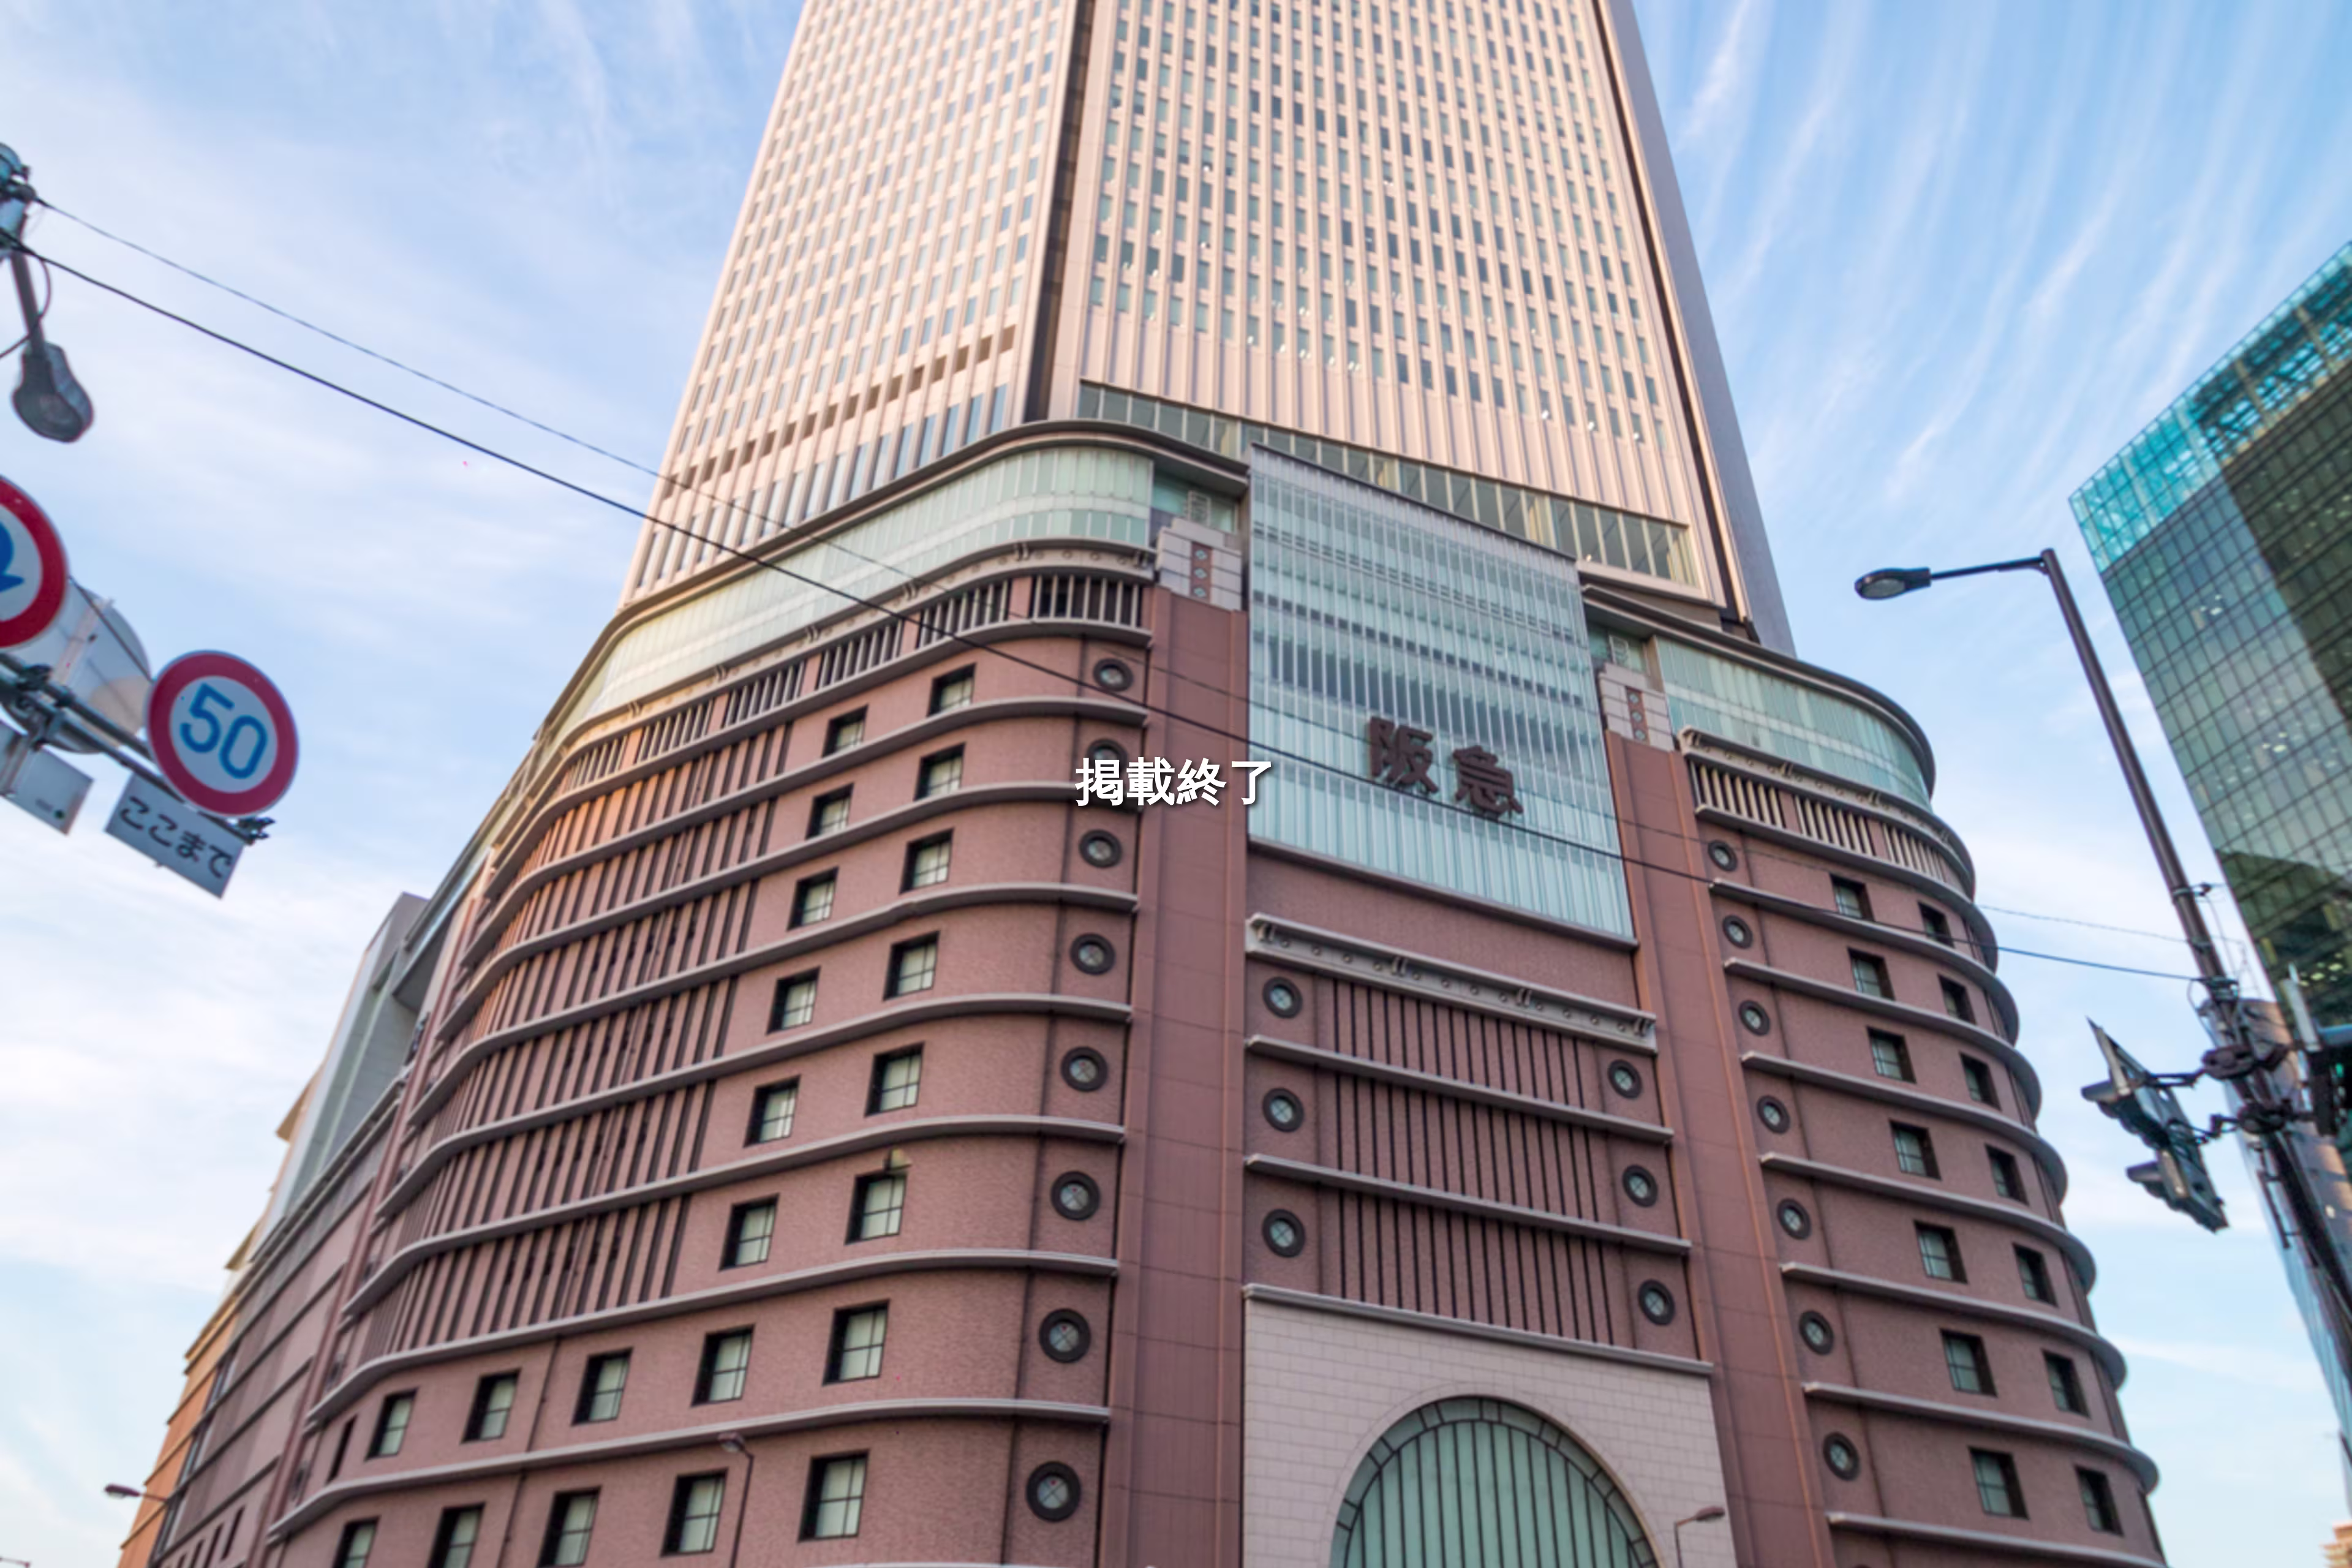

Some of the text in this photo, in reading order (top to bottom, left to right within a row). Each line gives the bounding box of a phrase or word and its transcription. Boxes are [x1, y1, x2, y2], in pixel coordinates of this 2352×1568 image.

[180, 683, 268, 780] 50
[1367, 716, 1523, 816] 阪急
[119, 796, 233, 878] ここまで
